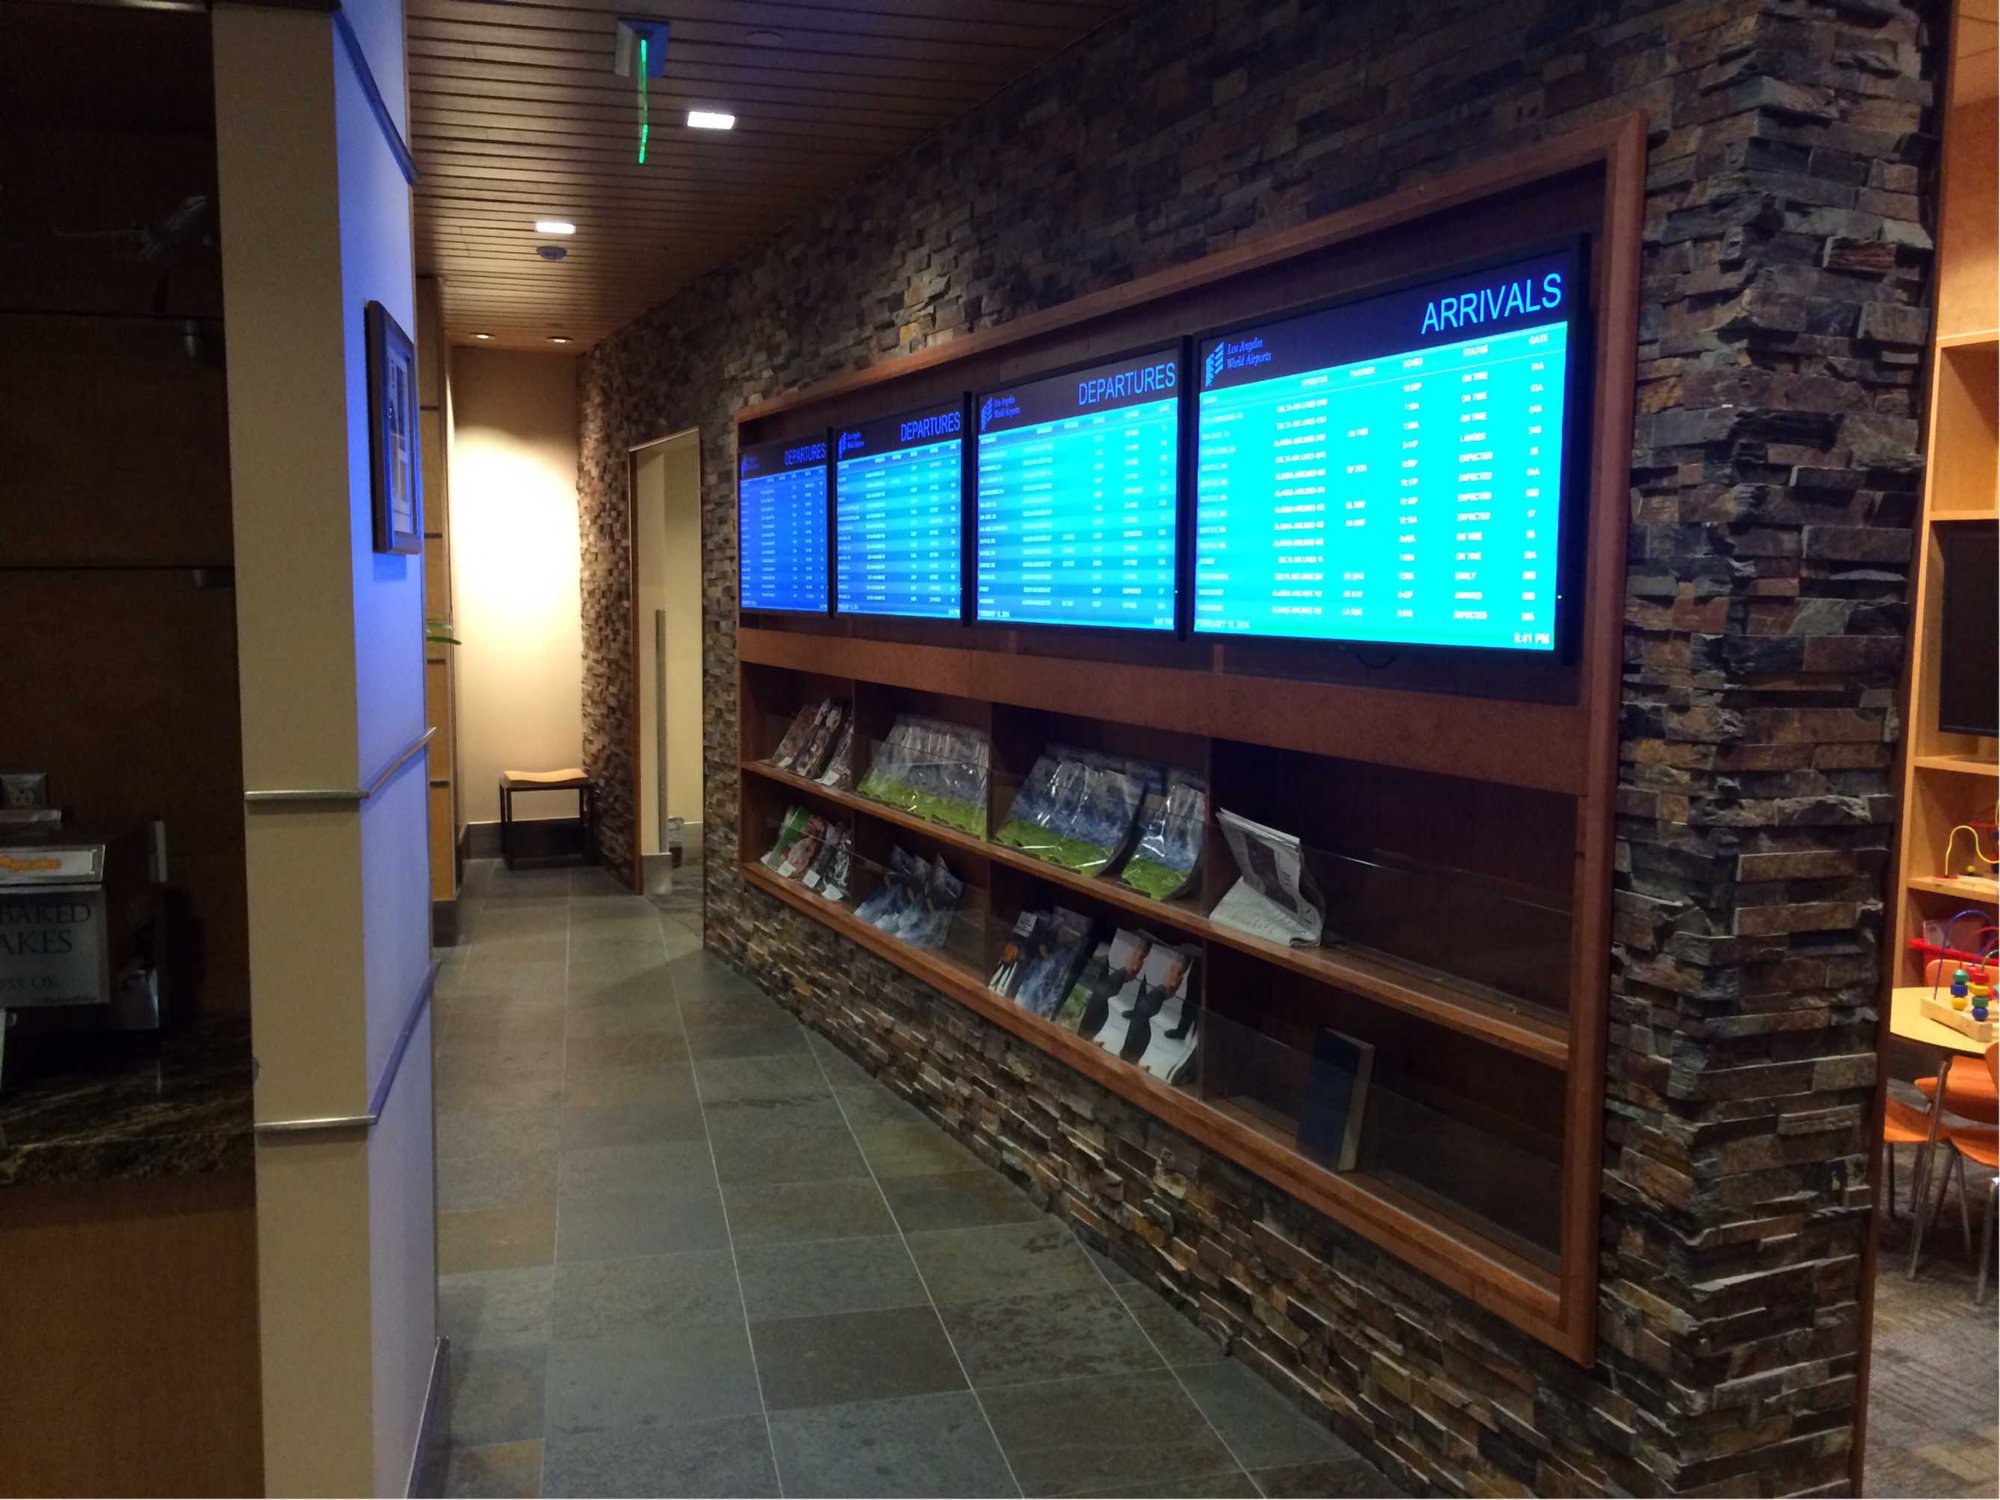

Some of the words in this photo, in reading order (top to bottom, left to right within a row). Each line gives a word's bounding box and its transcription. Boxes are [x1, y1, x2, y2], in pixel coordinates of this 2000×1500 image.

[1421, 273, 1562, 335] ARRIVALS
[1227, 344, 1239, 355] Los
[1239, 337, 1264, 352] Angeles
[1227, 355, 1245, 369] World
[1245, 352, 1272, 366] Airports
[1078, 362, 1176, 406] DEPARTURES
[900, 411, 961, 442] DEPARTURES
[784, 442, 827, 466] DEPARTURES
